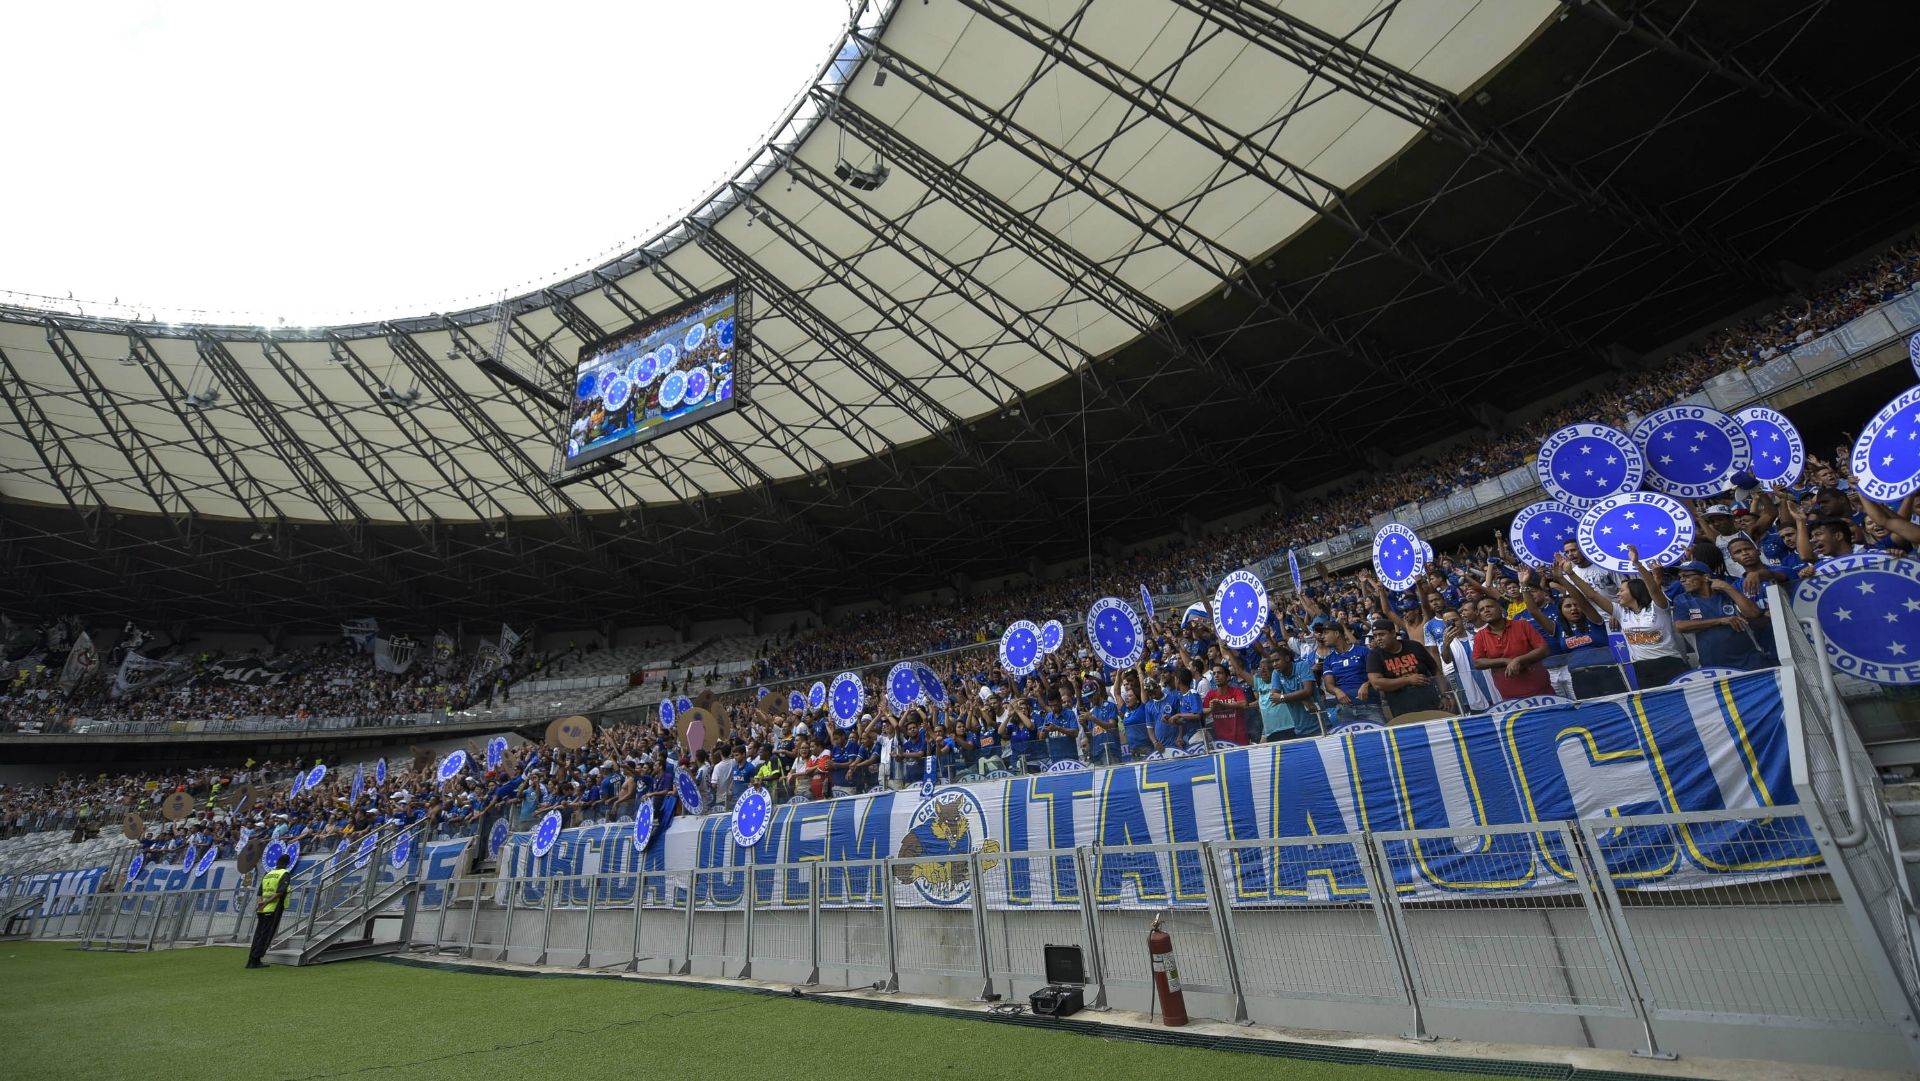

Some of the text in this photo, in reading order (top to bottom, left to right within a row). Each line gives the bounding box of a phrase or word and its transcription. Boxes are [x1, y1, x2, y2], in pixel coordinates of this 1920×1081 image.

[1634, 408, 1704, 450] RUZEIRO
[1714, 416, 1748, 471] CLUBE
[1751, 409, 1801, 465] CRUZEIRO
[1538, 427, 1580, 489] ESPORTE
[1591, 426, 1641, 493] CRUZEIRO
[1864, 474, 1920, 499] ESPOR
[1513, 502, 1582, 531] CRUZEIRO
[1629, 493, 1688, 521] CLUBE
[1375, 525, 1415, 547] CRUZEIRO
[1579, 499, 1618, 563] CRUZEIRO
[1222, 572, 1265, 597] ESPORTE
[1373, 554, 1404, 590] ESPORTE
[1799, 556, 1920, 602] CRUZEIR
[1088, 600, 1109, 651] CRUZEIRO
[1115, 599, 1142, 635] CLUBE
[1213, 589, 1223, 634] CLUBE
[1225, 605, 1267, 646] CRUZEIRO
[1001, 621, 1035, 646] CRUZEIRO
[1001, 652, 1032, 675] ESPORTE
[1105, 640, 1143, 667] ESPORTE
